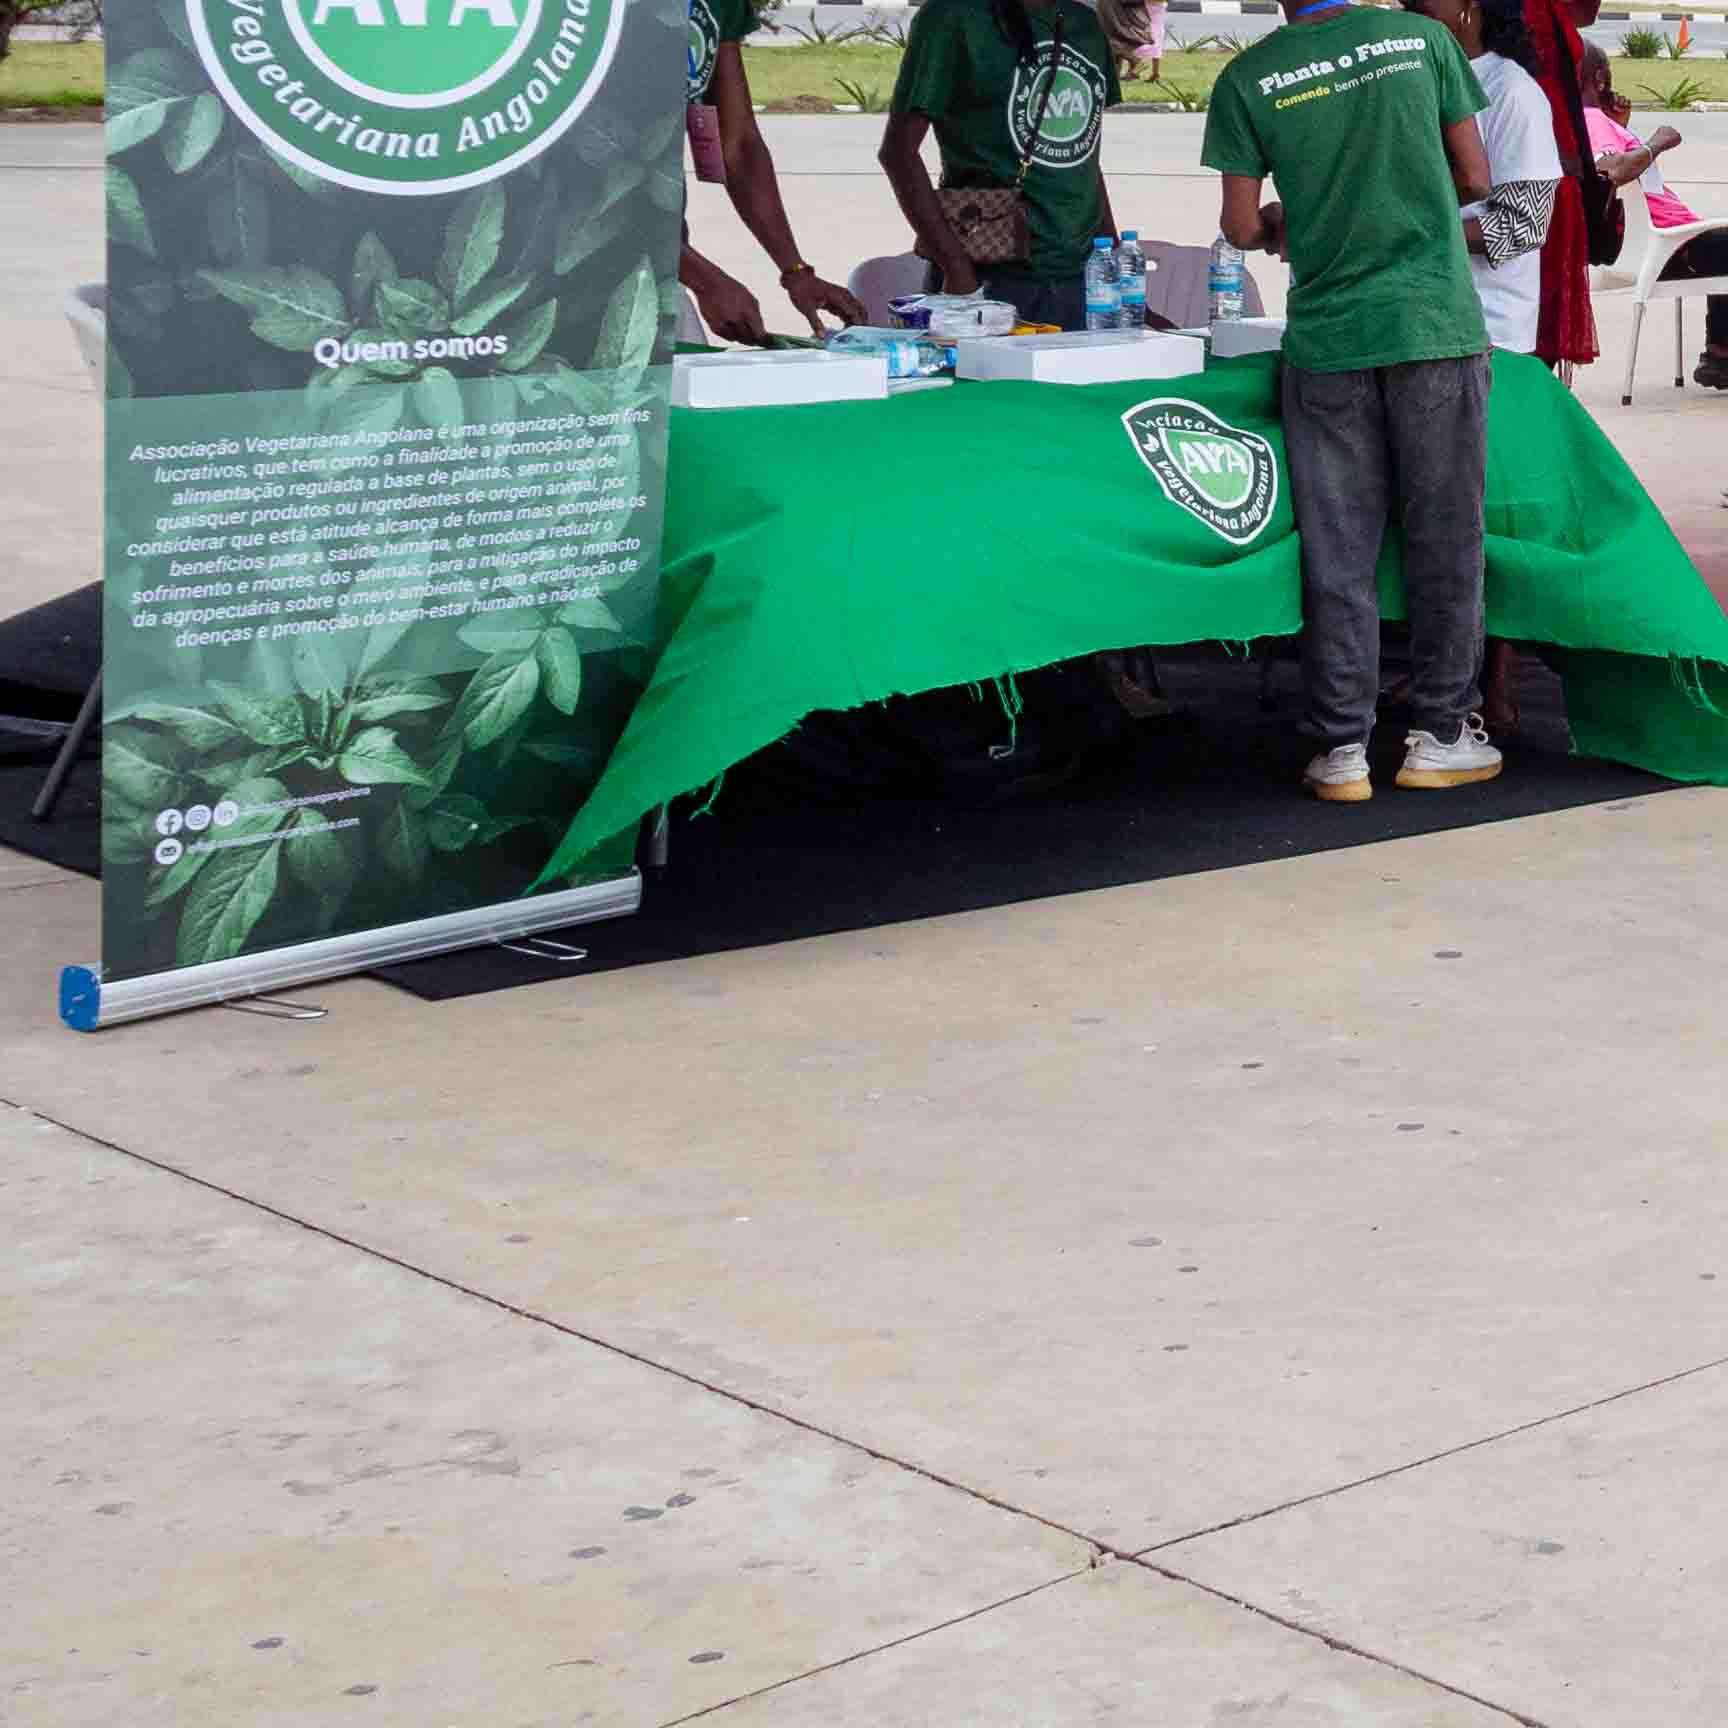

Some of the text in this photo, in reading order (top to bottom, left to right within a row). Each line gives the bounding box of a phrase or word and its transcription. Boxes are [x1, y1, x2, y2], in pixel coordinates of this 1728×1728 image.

[1258, 37, 1426, 96] Planta o Futuro
[1334, 78, 1360, 93] bem
[1361, 71, 1374, 84] no
[314, 335, 508, 368] Quem somos
[129, 439, 239, 463] Associação
[245, 432, 350, 453] Vegetariana
[355, 426, 433, 448] Angolana
[491, 414, 583, 435] organização
[588, 412, 620, 427] sem
[623, 407, 650, 423] fins
[154, 463, 248, 483] lucrativos,
[253, 461, 288, 478] que
[332, 454, 379, 471] como
[383, 453, 394, 467] a
[398, 443, 478, 465] finalidade
[482, 444, 490, 458] a
[494, 438, 573, 462] promoção
[576, 434, 595, 450] de
[156, 509, 248, 534] quaisquer
[252, 502, 331, 529] produtos
[335, 500, 356, 517] ou
[360, 491, 462, 515] ingredientes
[465, 486, 487, 504] de
[489, 481, 543, 504] origem
[601, 473, 626, 494] por
[171, 481, 285, 507] alimentação
[288, 475, 364, 499] regulada
[368, 476, 379, 491] a
[383, 471, 425, 489] base
[427, 468, 449, 486] de
[517, 460, 549, 477] sem
[597, 453, 617, 469] de
[1157, 459, 1269, 529] Vegetariana Angolana
[127, 535, 226, 557] considerar
[231, 531, 264, 552] que
[311, 520, 370, 541] atitude
[375, 513, 439, 538] alcança
[442, 511, 463, 530] de
[466, 506, 513, 527] forma
[516, 503, 553, 522] mais
[628, 493, 647, 510] os
[268, 551, 308, 571] para
[311, 550, 324, 564] a
[328, 541, 379, 563] saúde
[455, 532, 475, 550] de
[479, 527, 532, 547] modos
[535, 526, 545, 540] a
[548, 520, 601, 538] reduzir
[131, 581, 233, 606] sofrimento
[236, 580, 248, 594] e
[252, 572, 315, 593] mortes
[319, 567, 352, 587] dos
[427, 558, 464, 579] para
[466, 557, 477, 571] a
[480, 546, 556, 570] mitigação
[559, 541, 579, 559] do
[581, 535, 641, 558] impacto
[131, 610, 157, 628] da
[161, 598, 282, 628] agropecuária
[284, 591, 334, 612] sobre
[337, 592, 350, 608] o
[479, 576, 489, 591] e
[492, 572, 527, 593] para
[530, 559, 616, 585] erradicação
[619, 557, 639, 574] de
[175, 624, 253, 649] doenças
[256, 623, 268, 639] e
[272, 613, 359, 641] promoção
[362, 610, 386, 628] do
[389, 598, 471, 623] bem-estar
[471, 593, 536, 614] humano
[537, 591, 548, 604] e
[550, 584, 579, 603] não
